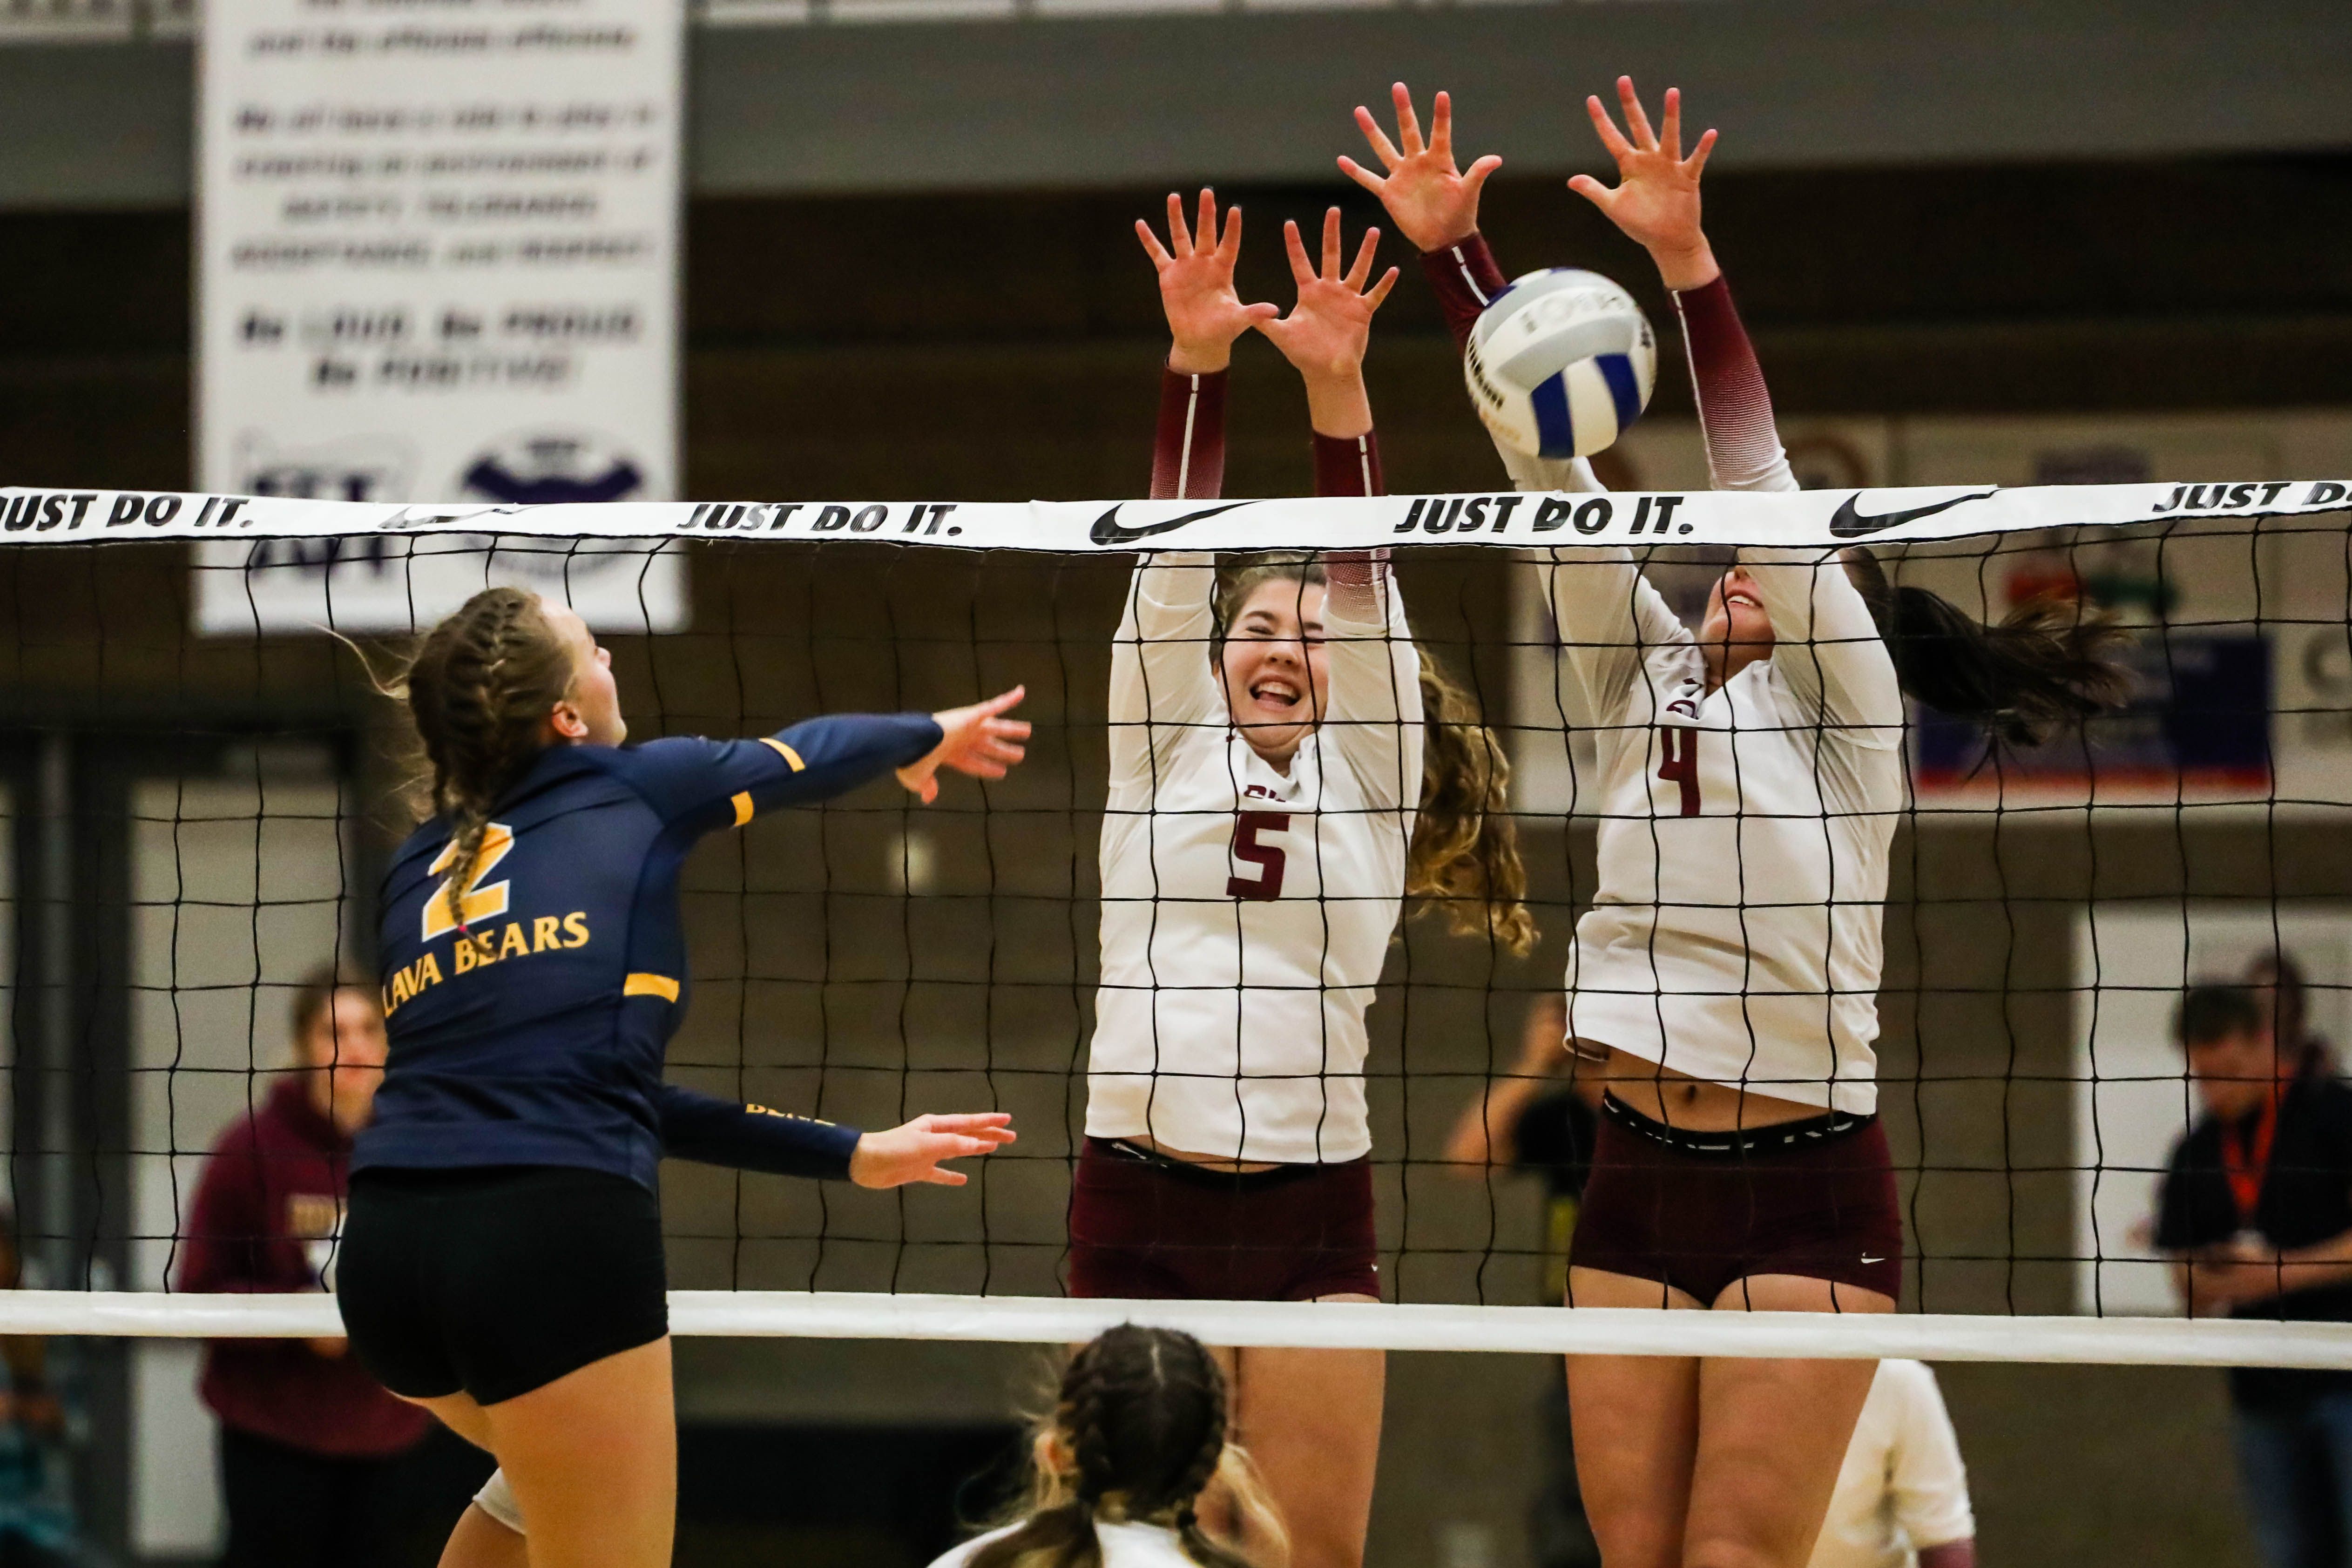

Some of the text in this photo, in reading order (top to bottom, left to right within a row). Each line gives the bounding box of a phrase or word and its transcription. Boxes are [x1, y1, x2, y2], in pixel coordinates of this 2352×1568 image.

[106, 495, 182, 527] DO
[194, 497, 254, 528] IT.
[676, 504, 962, 536] JUST DO IT.
[1393, 496, 1694, 535] JUST DO IT.
[2151, 482, 2352, 512] JUST D
[1657, 724, 1701, 816] 4
[421, 822, 514, 942] 2
[1226, 811, 1291, 902] 5
[383, 911, 589, 1018] LAVA BEARS
